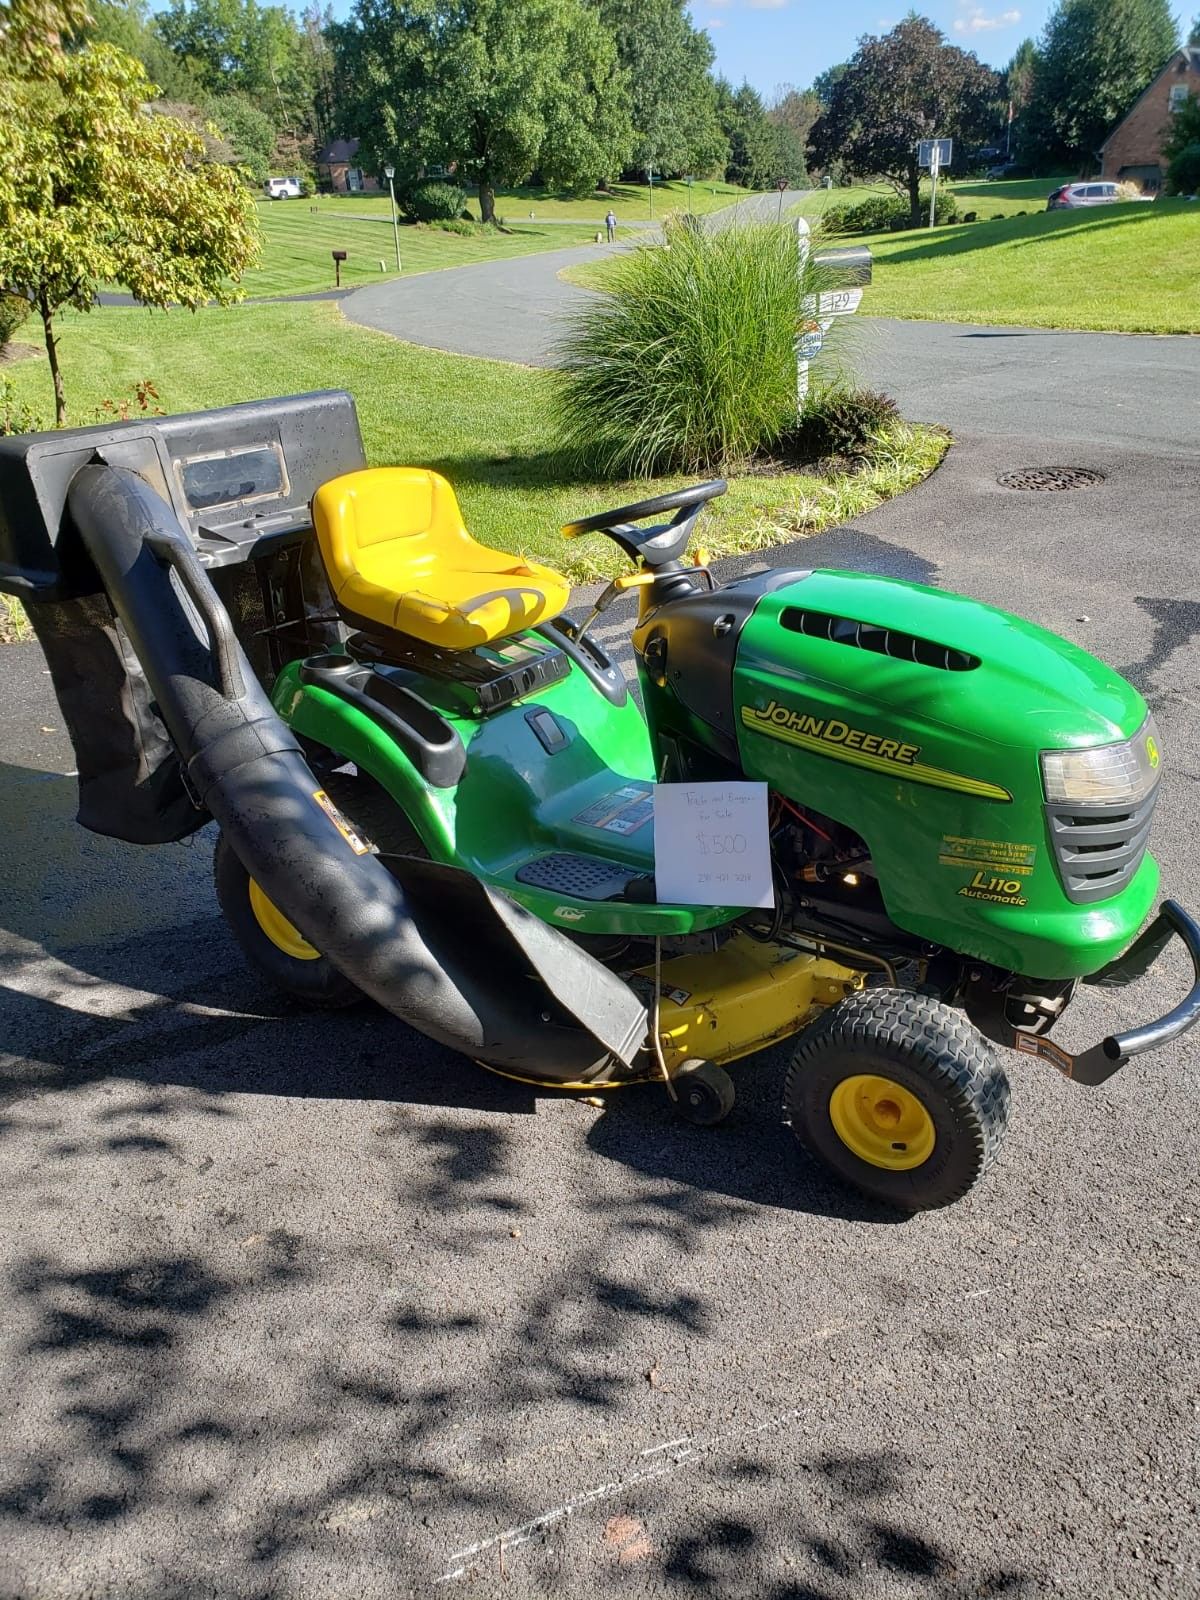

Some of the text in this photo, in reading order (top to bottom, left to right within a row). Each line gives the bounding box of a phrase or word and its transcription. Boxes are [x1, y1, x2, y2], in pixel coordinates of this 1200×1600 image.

[755, 701, 921, 765] JOHN DEERE
[971, 872, 1022, 894] L110
[957, 887, 1028, 906] Automatic
